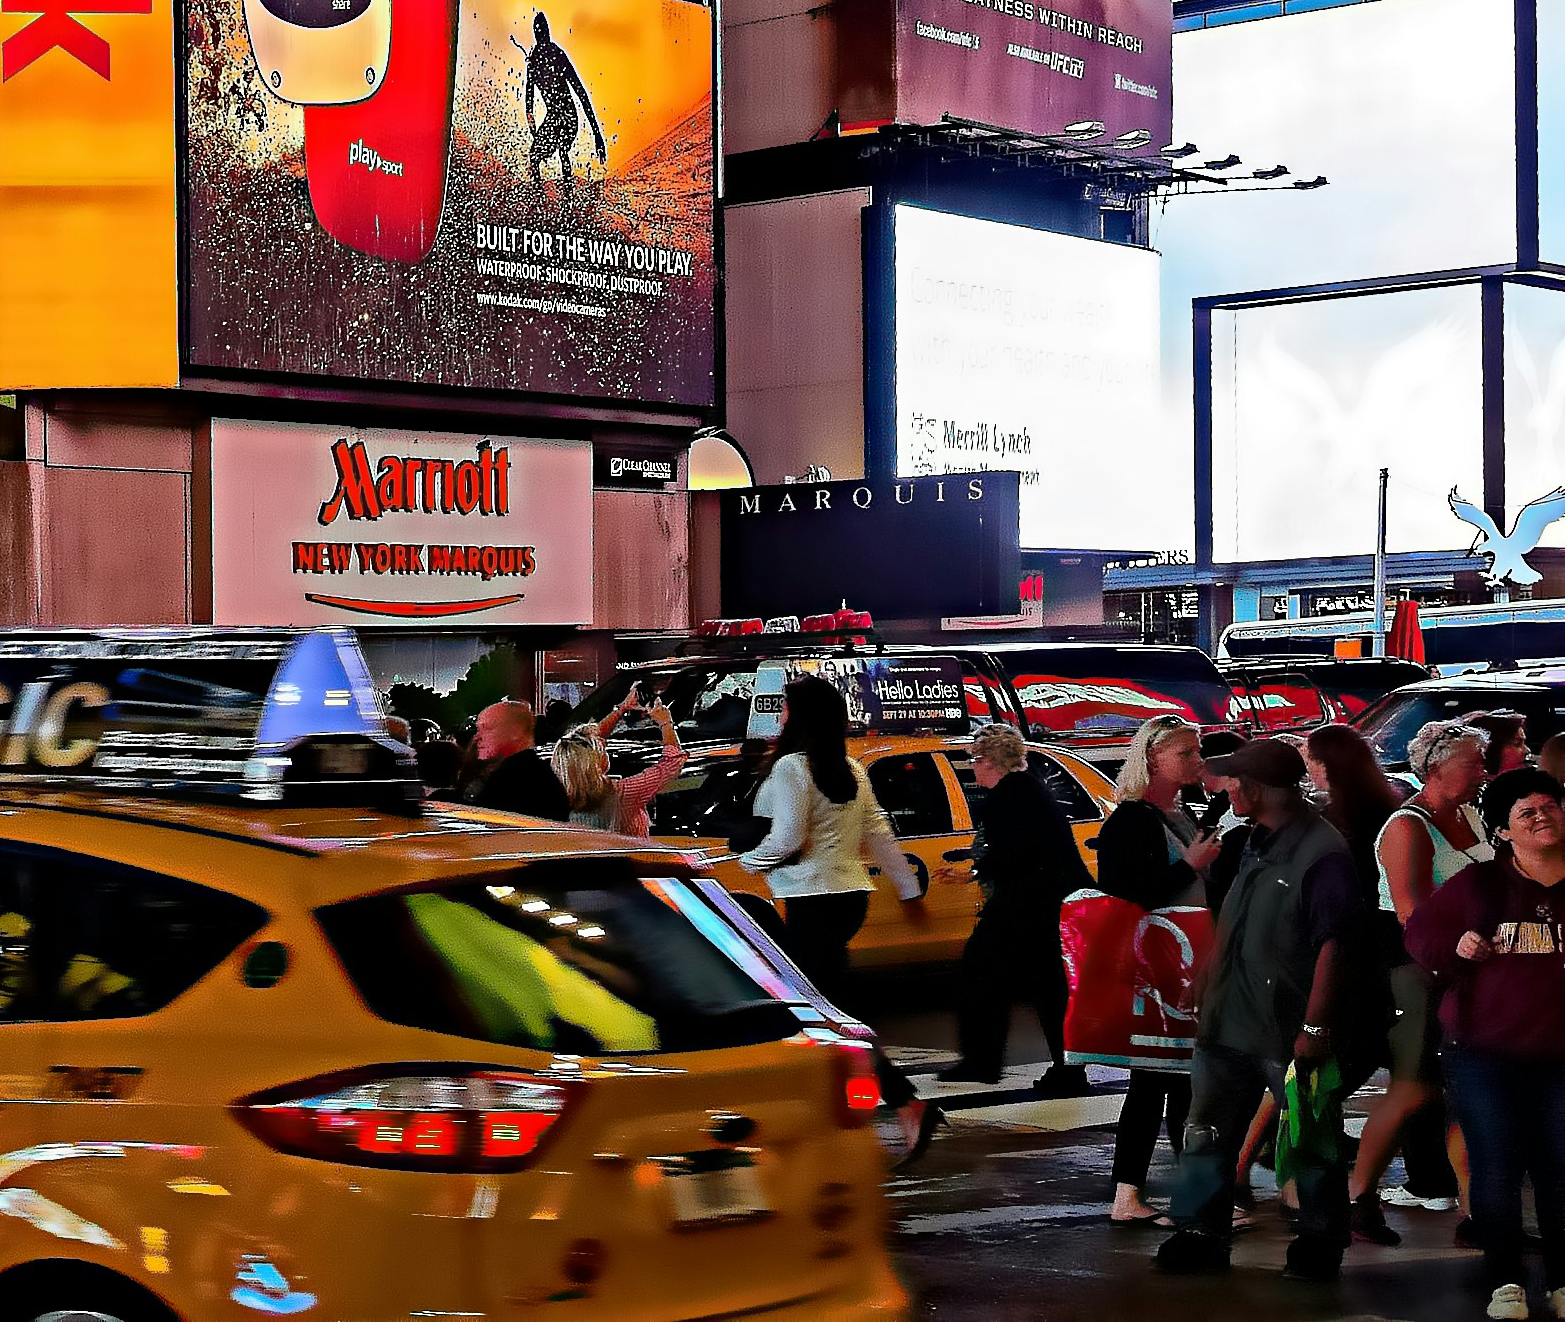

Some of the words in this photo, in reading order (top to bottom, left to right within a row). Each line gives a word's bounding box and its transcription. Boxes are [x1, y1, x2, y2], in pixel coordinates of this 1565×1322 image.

[1037, 6, 1093, 40] WITHIN
[1097, 26, 1144, 54] REACH
[476, 223, 518, 254] BUILT
[523, 230, 554, 258] FOR
[555, 234, 586, 263] THE
[586, 238, 624, 268] WAY
[624, 244, 657, 273] YOU
[657, 248, 694, 278] PLAY.
[943, 419, 989, 453] Merrill
[992, 423, 1032, 458] Lynch
[318, 438, 511, 526] Marriott
[739, 478, 984, 515] MARQUIS
[295, 542, 353, 576] NEW
[354, 543, 426, 576] YORK
[427, 545, 536, 581] MARQUIS
[877, 679, 914, 701] Hello
[914, 679, 959, 700] Ladies
